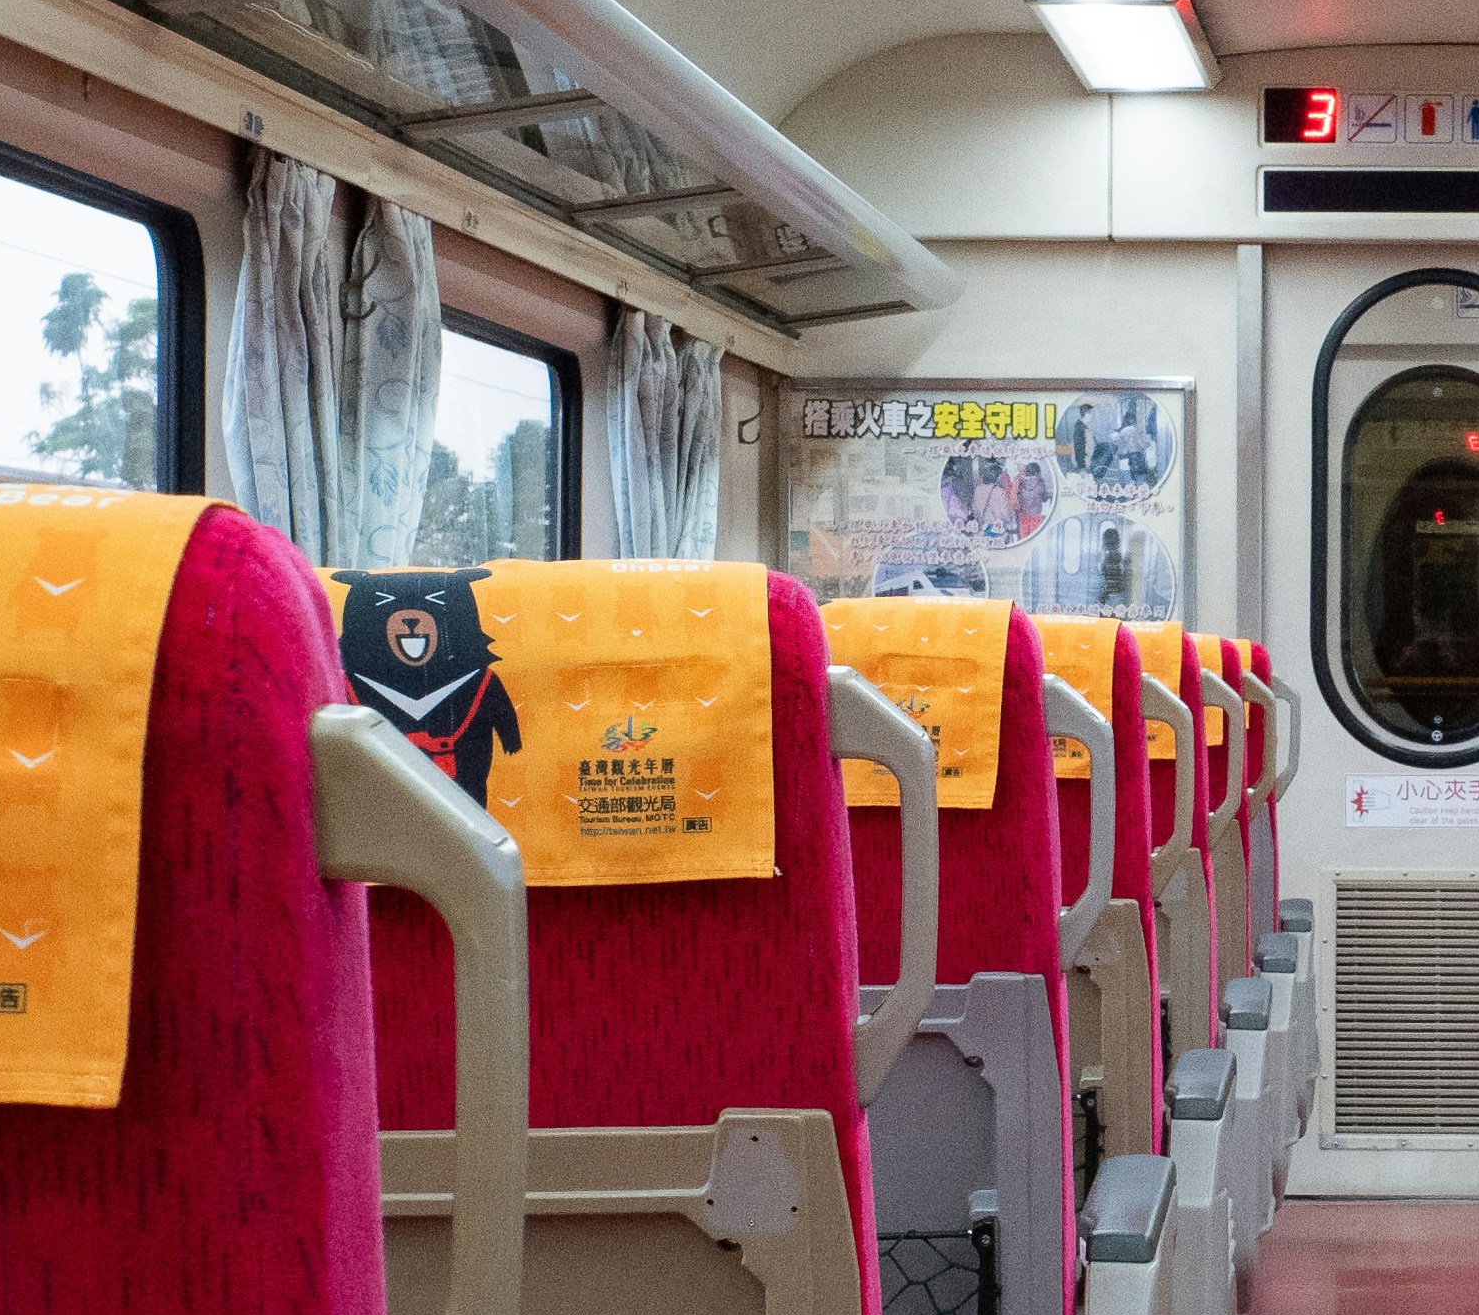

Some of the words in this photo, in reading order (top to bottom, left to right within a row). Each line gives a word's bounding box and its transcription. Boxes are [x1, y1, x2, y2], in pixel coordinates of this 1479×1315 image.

[1304, 93, 1336, 138] 3
[578, 795, 676, 814] 交通部觀光局
